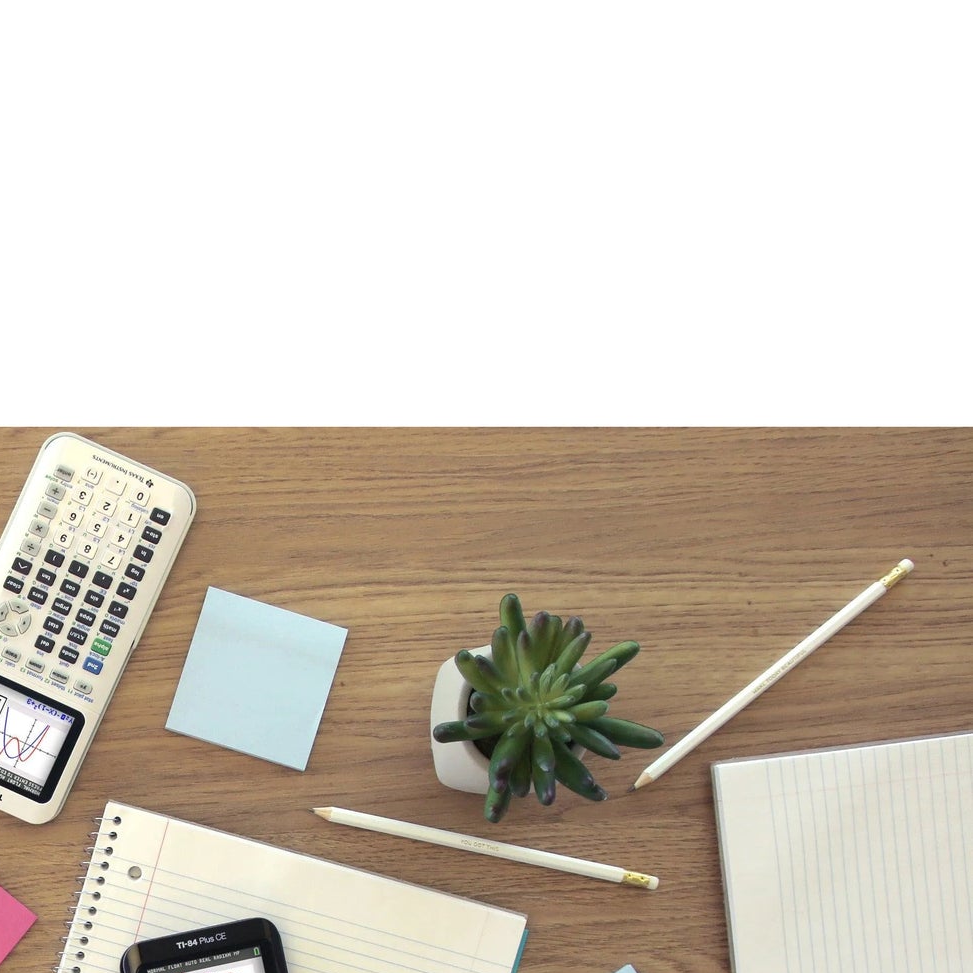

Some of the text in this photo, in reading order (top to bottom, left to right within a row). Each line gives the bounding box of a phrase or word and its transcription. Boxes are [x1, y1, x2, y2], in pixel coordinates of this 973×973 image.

[92, 454, 145, 483] TEXAS INSTRUMENTS
[79, 491, 87, 500] 3
[136, 492, 144, 501] 0
[102, 501, 111, 511] 2
[69, 512, 77, 521] 6
[127, 513, 134, 522] 1
[93, 523, 101, 532] 5
[60, 534, 68, 543] 9
[117, 534, 125, 543] 4
[83, 545, 92, 554] 8
[107, 556, 115, 565] 7
[130, 567, 140, 575] log
[7, 580, 22, 590] clear
[32, 591, 44, 599] vars
[54, 601, 70, 610] prgm
[79, 612, 92, 621] apps
[103, 623, 117, 633] math
[176, 932, 227, 949] TI-84 Plus CE
[185, 959, 197, 967] AUTO
[213, 952, 232, 960] RADIAN
